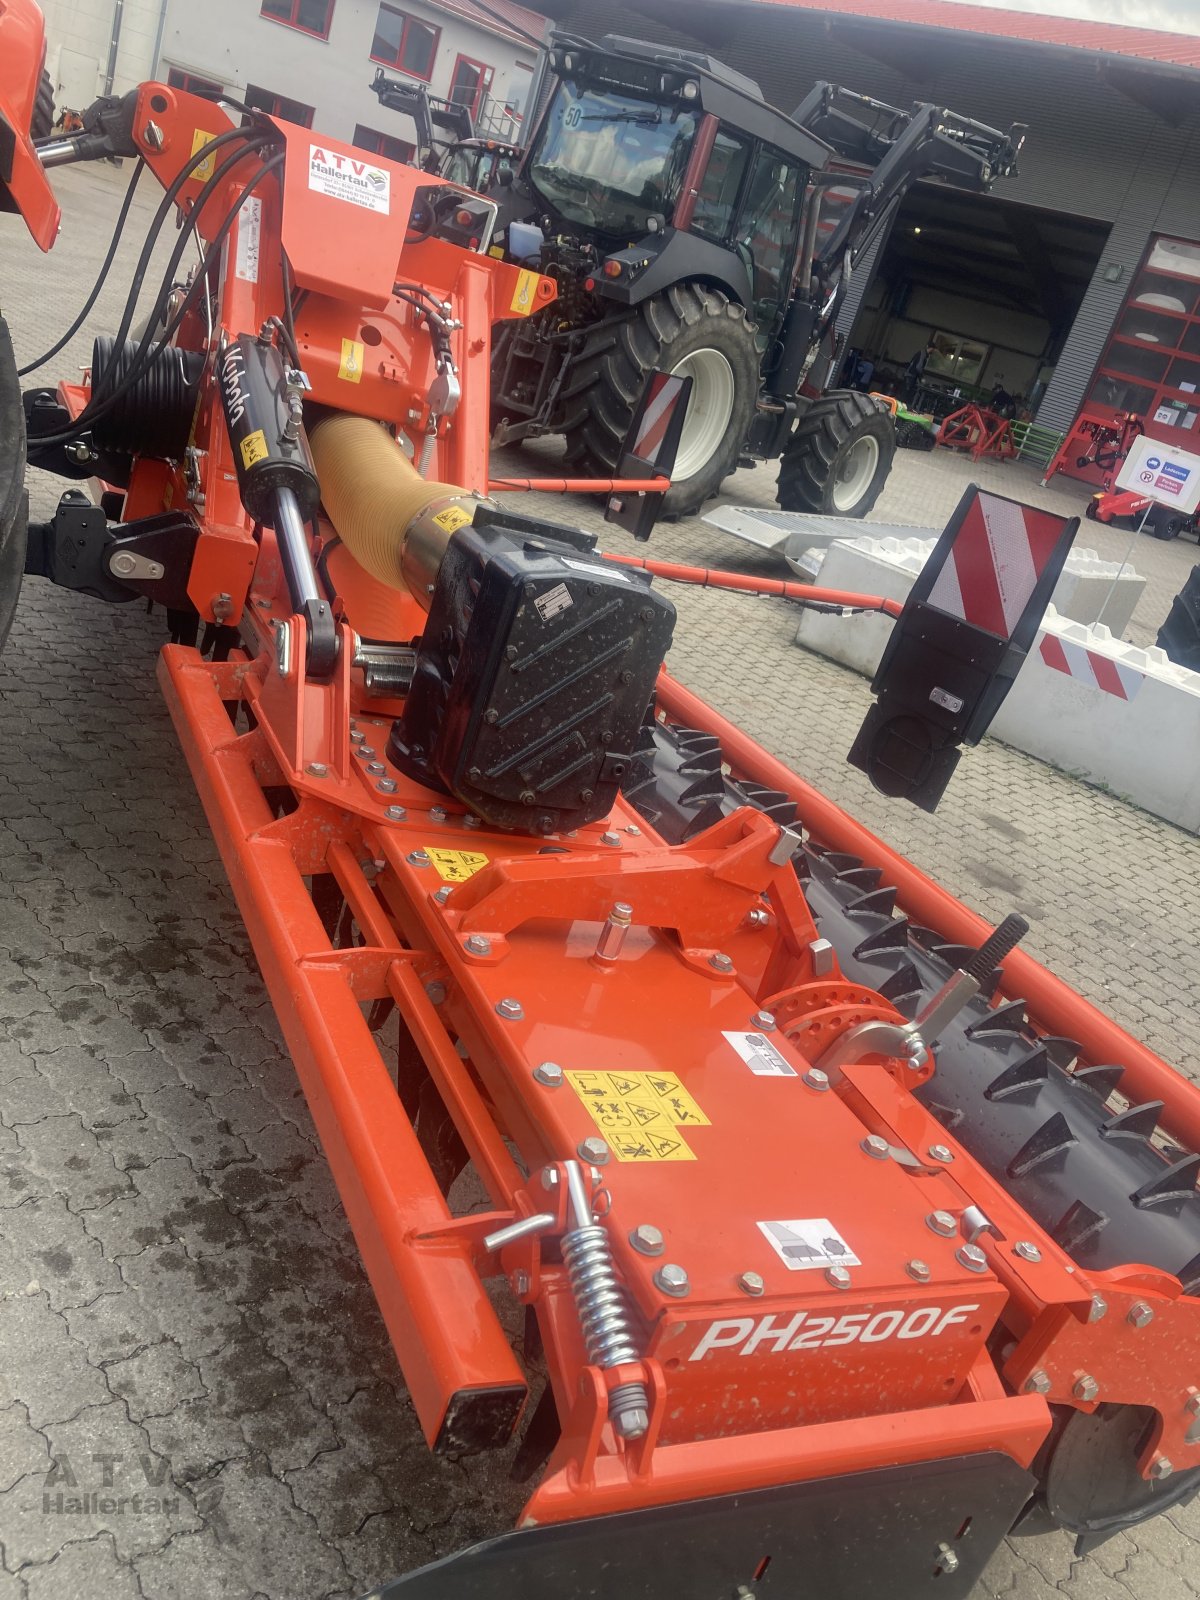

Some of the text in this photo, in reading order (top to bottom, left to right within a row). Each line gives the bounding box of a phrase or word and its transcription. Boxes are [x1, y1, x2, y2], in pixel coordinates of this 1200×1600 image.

[565, 107, 581, 127] 50
[311, 161, 368, 188] Hallertau
[222, 347, 250, 427] Kubota
[688, 1304, 980, 1361] PH2500F
